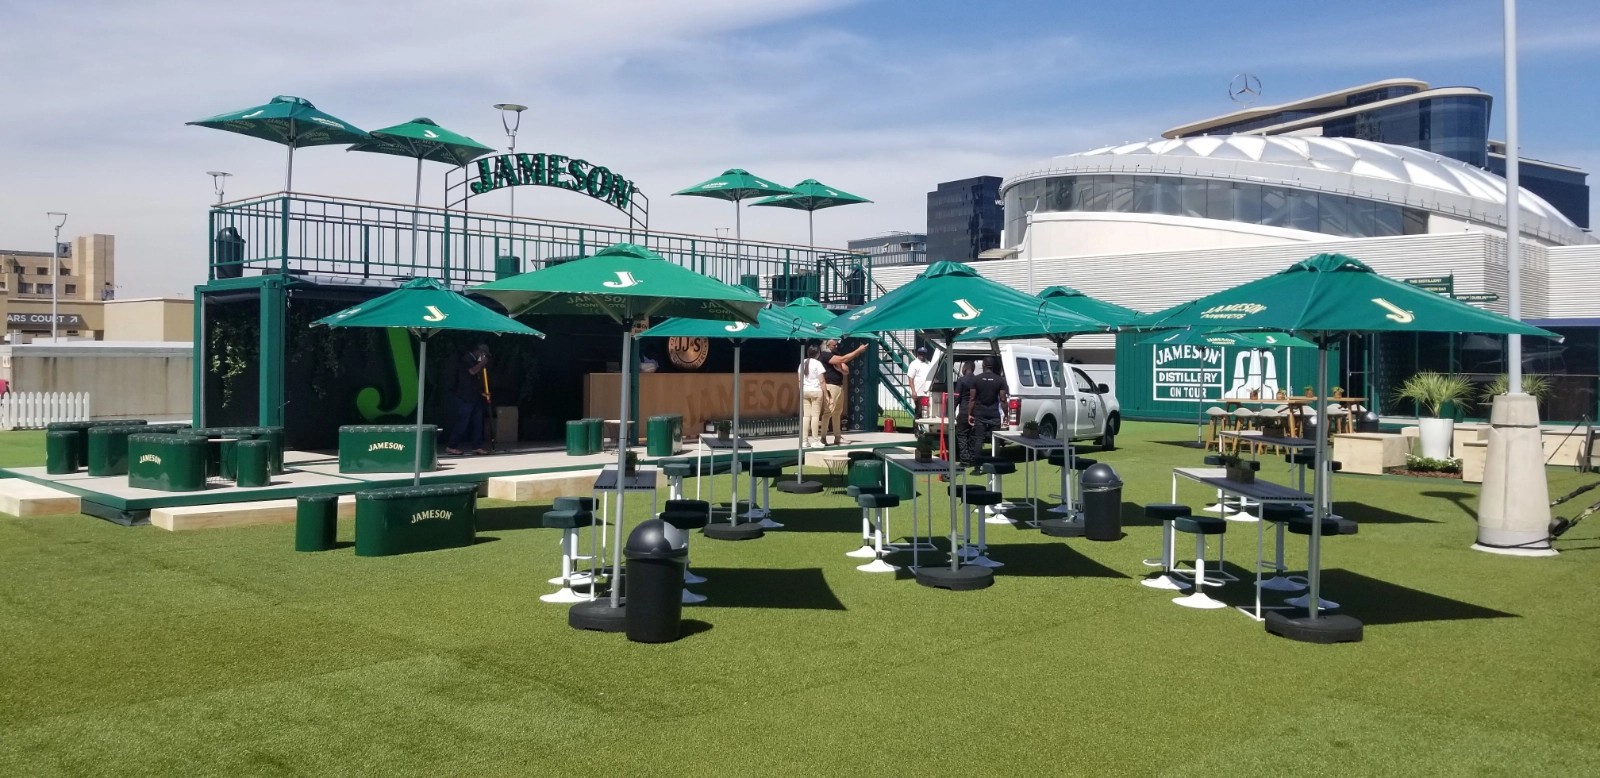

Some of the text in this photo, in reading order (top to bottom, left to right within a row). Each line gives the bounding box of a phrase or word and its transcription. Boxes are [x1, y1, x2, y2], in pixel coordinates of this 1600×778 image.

[470, 152, 634, 209] JAMESON
[1156, 344, 1220, 365] JAMESON
[1158, 372, 1218, 383] DISTILLERY
[1170, 387, 1207, 398] ON TOUR
[686, 379, 802, 428] JAMESO
[368, 441, 404, 452] JAMESON
[139, 453, 162, 465] JAMESON
[411, 509, 452, 524] JAMESON
